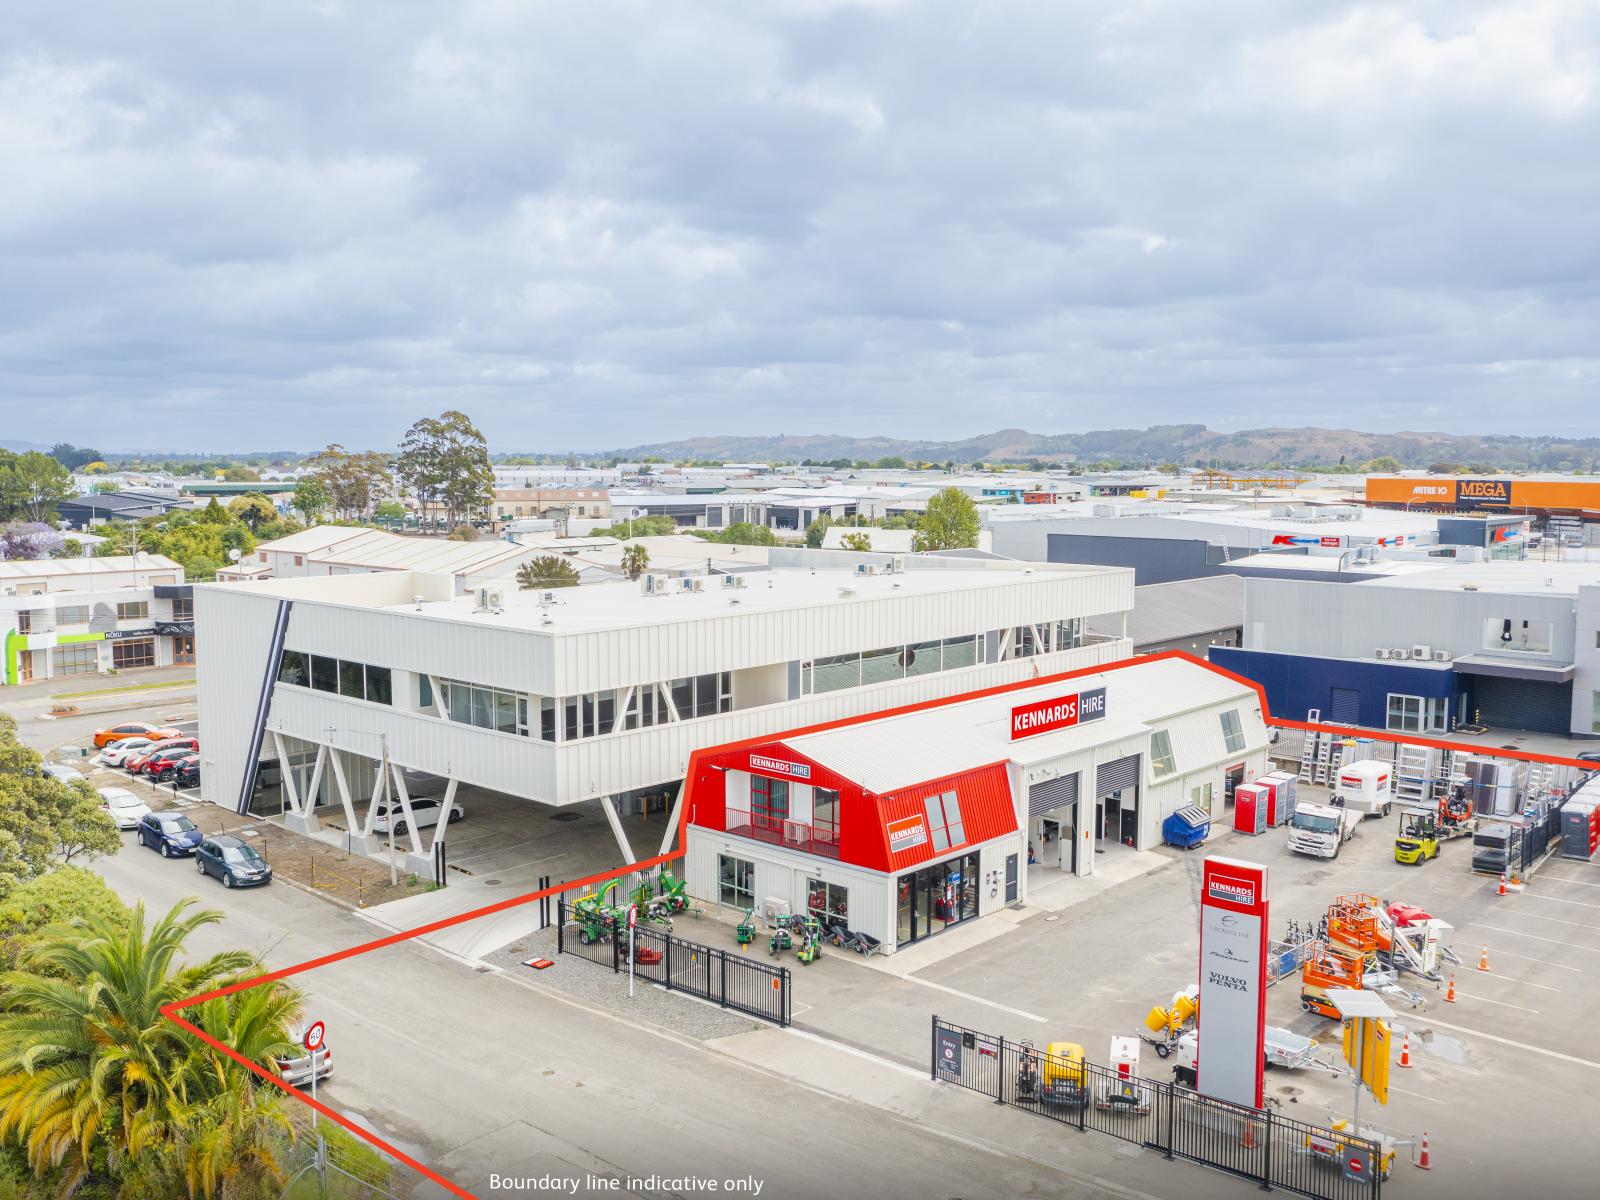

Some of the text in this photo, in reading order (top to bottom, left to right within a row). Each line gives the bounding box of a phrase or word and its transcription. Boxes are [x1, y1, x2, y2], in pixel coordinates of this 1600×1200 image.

[1413, 486, 1448, 495] MITRE 10
[1460, 482, 1507, 497] MEGA
[1014, 695, 1104, 732] KENNARDS HIRE
[752, 757, 808, 776] KENNARDS HIRE
[890, 825, 924, 841] KENNARDS
[912, 833, 925, 844] HIRE
[1210, 882, 1252, 896] KENNARDS
[1235, 895, 1252, 904] HIRE
[1208, 976, 1248, 992] PENTA
[1209, 971, 1247, 986] VOLVO
[310, 1029, 321, 1044] 50
[942, 1039, 956, 1050] Entry
